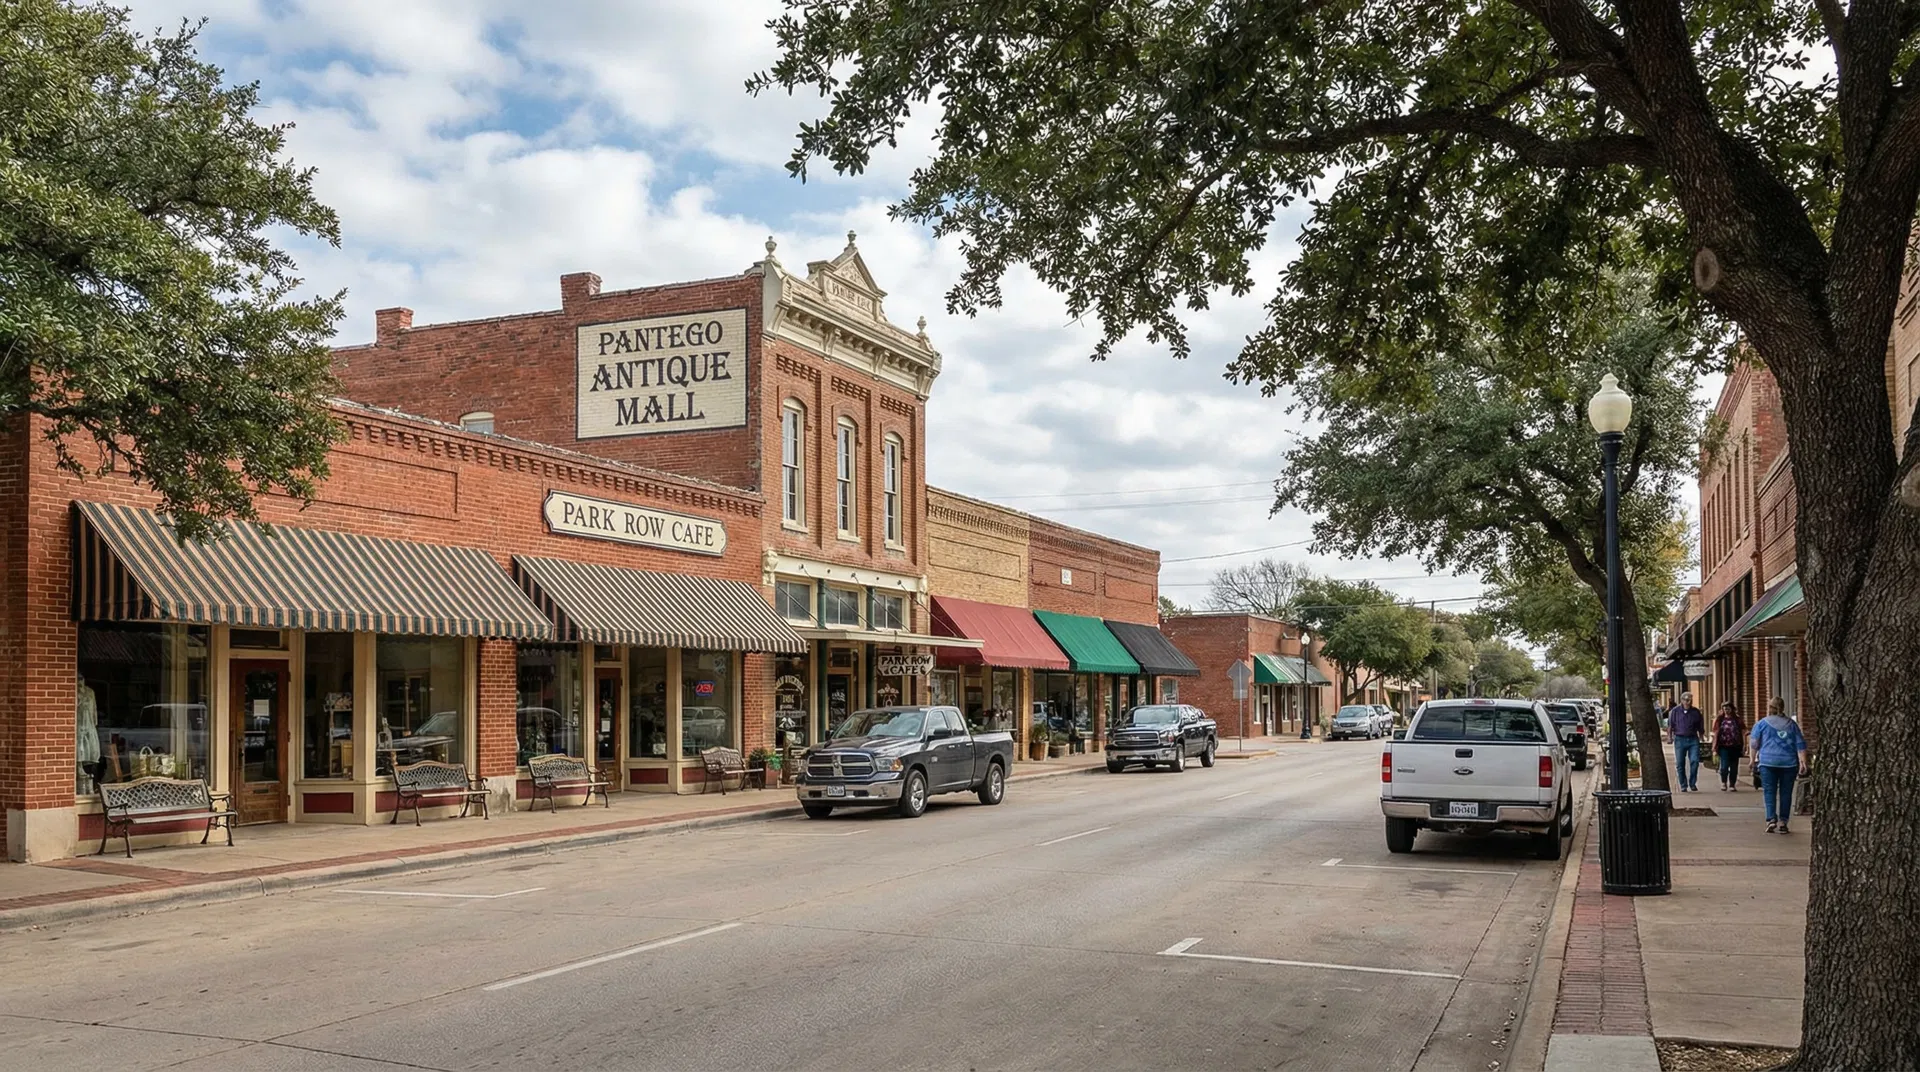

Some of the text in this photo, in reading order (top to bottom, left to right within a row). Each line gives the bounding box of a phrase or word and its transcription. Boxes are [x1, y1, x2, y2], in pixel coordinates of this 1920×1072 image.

[598, 320, 723, 355] PANTEGO
[590, 352, 732, 392] ANTIQUE
[615, 392, 705, 426] MALL
[562, 501, 714, 547] PARK ROW CAFE
[881, 656, 931, 665] PARK ROW
[890, 665, 918, 675] CAFE
